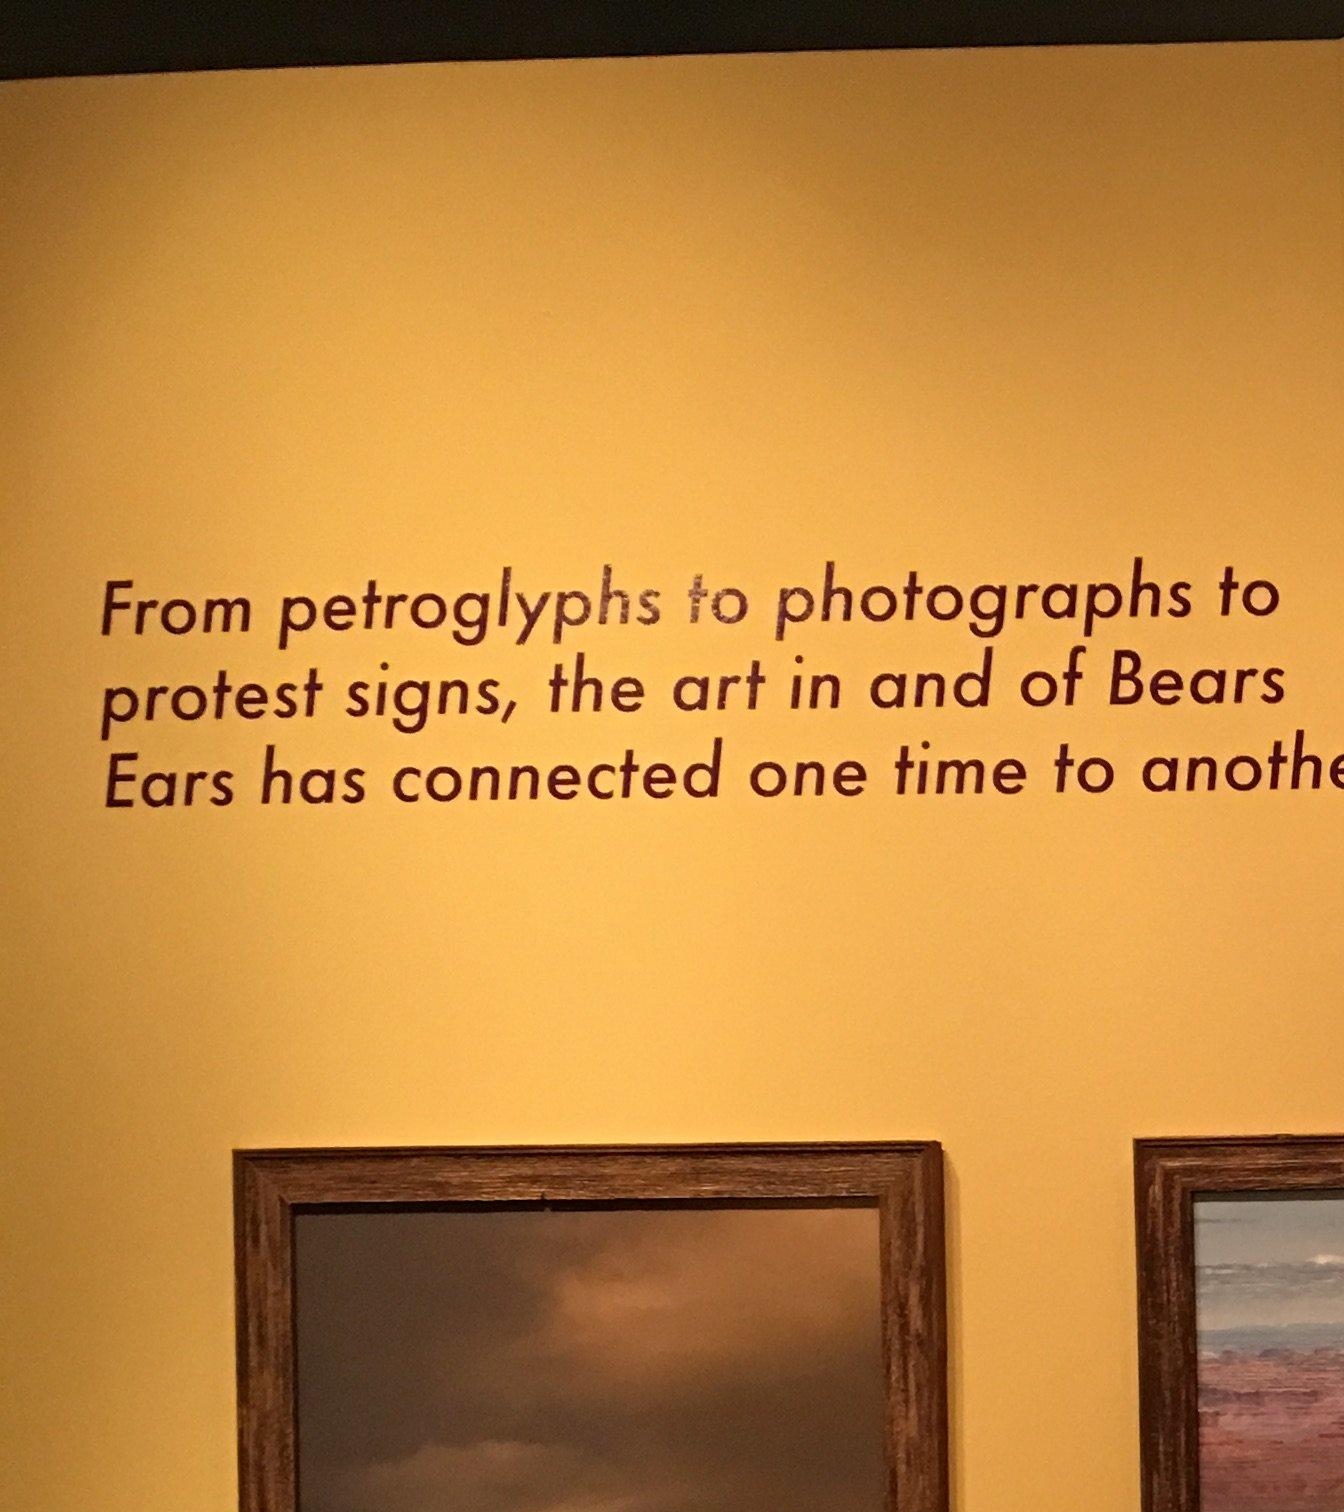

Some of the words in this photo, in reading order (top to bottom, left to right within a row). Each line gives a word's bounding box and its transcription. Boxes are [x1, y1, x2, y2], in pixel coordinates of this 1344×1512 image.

[100, 579, 251, 636] From
[278, 564, 660, 651] petroglyphs
[688, 573, 748, 624] to
[774, 556, 1192, 642] photographs
[1219, 566, 1279, 617] to
[100, 668, 323, 742] protest
[346, 661, 517, 735] signs,
[548, 652, 645, 713] the
[673, 660, 766, 711] art
[790, 654, 840, 709] in
[870, 646, 994, 709] and
[1020, 645, 1087, 707] of
[1109, 649, 1285, 706] Bears
[105, 752, 234, 808] Ears
[261, 744, 365, 805] has
[393, 737, 723, 803] connected
[750, 760, 867, 797] one
[895, 740, 1027, 795] time
[1054, 743, 1114, 793] to
